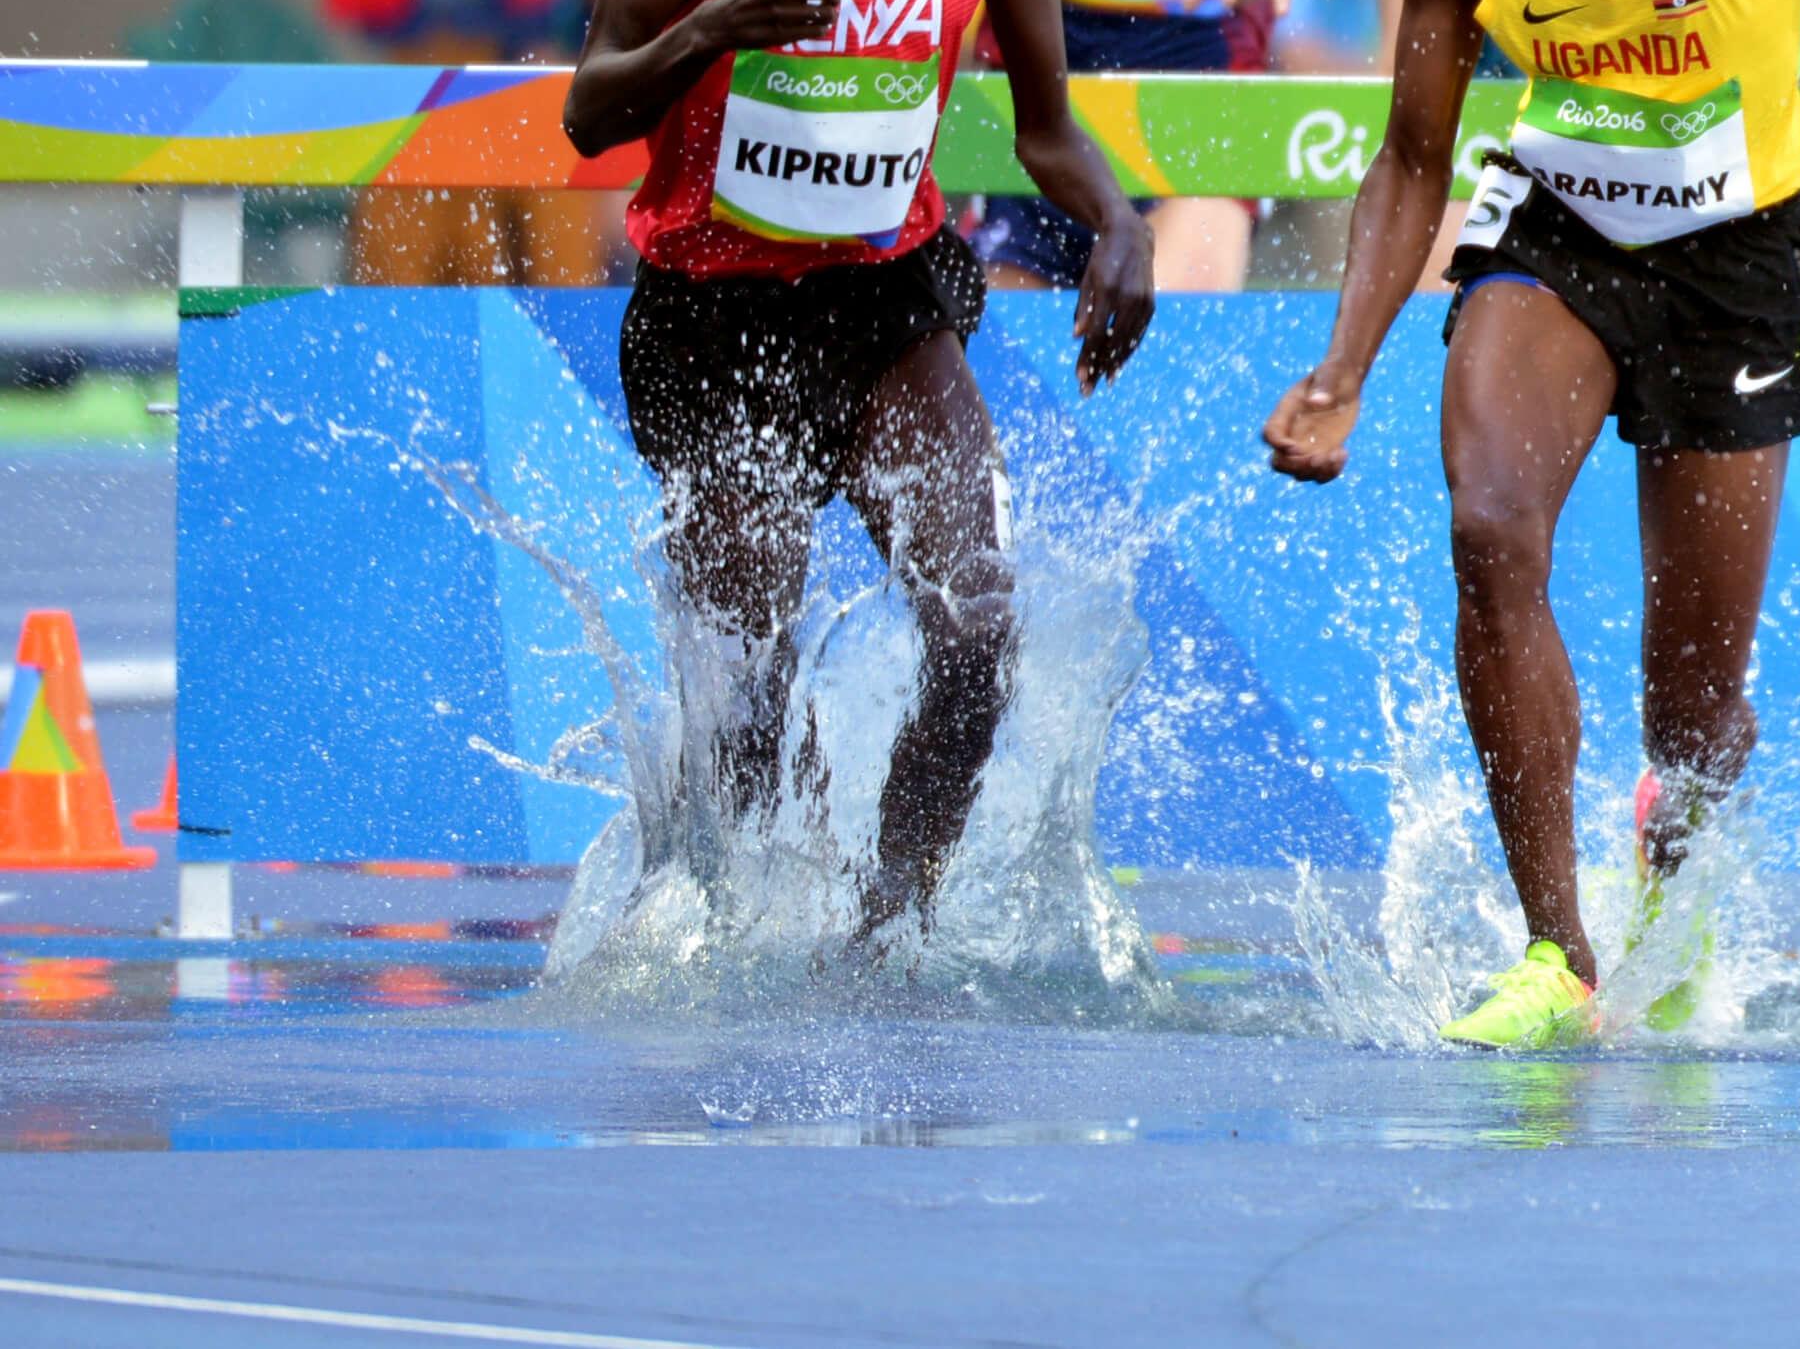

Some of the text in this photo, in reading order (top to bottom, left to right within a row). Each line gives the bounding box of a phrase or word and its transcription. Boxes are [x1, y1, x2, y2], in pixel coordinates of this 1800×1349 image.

[1531, 30, 1711, 79] UGANDA
[767, 69, 860, 98] Rio2016
[1555, 97, 1647, 135] Rio2016
[734, 137, 926, 189] KIPRUTO
